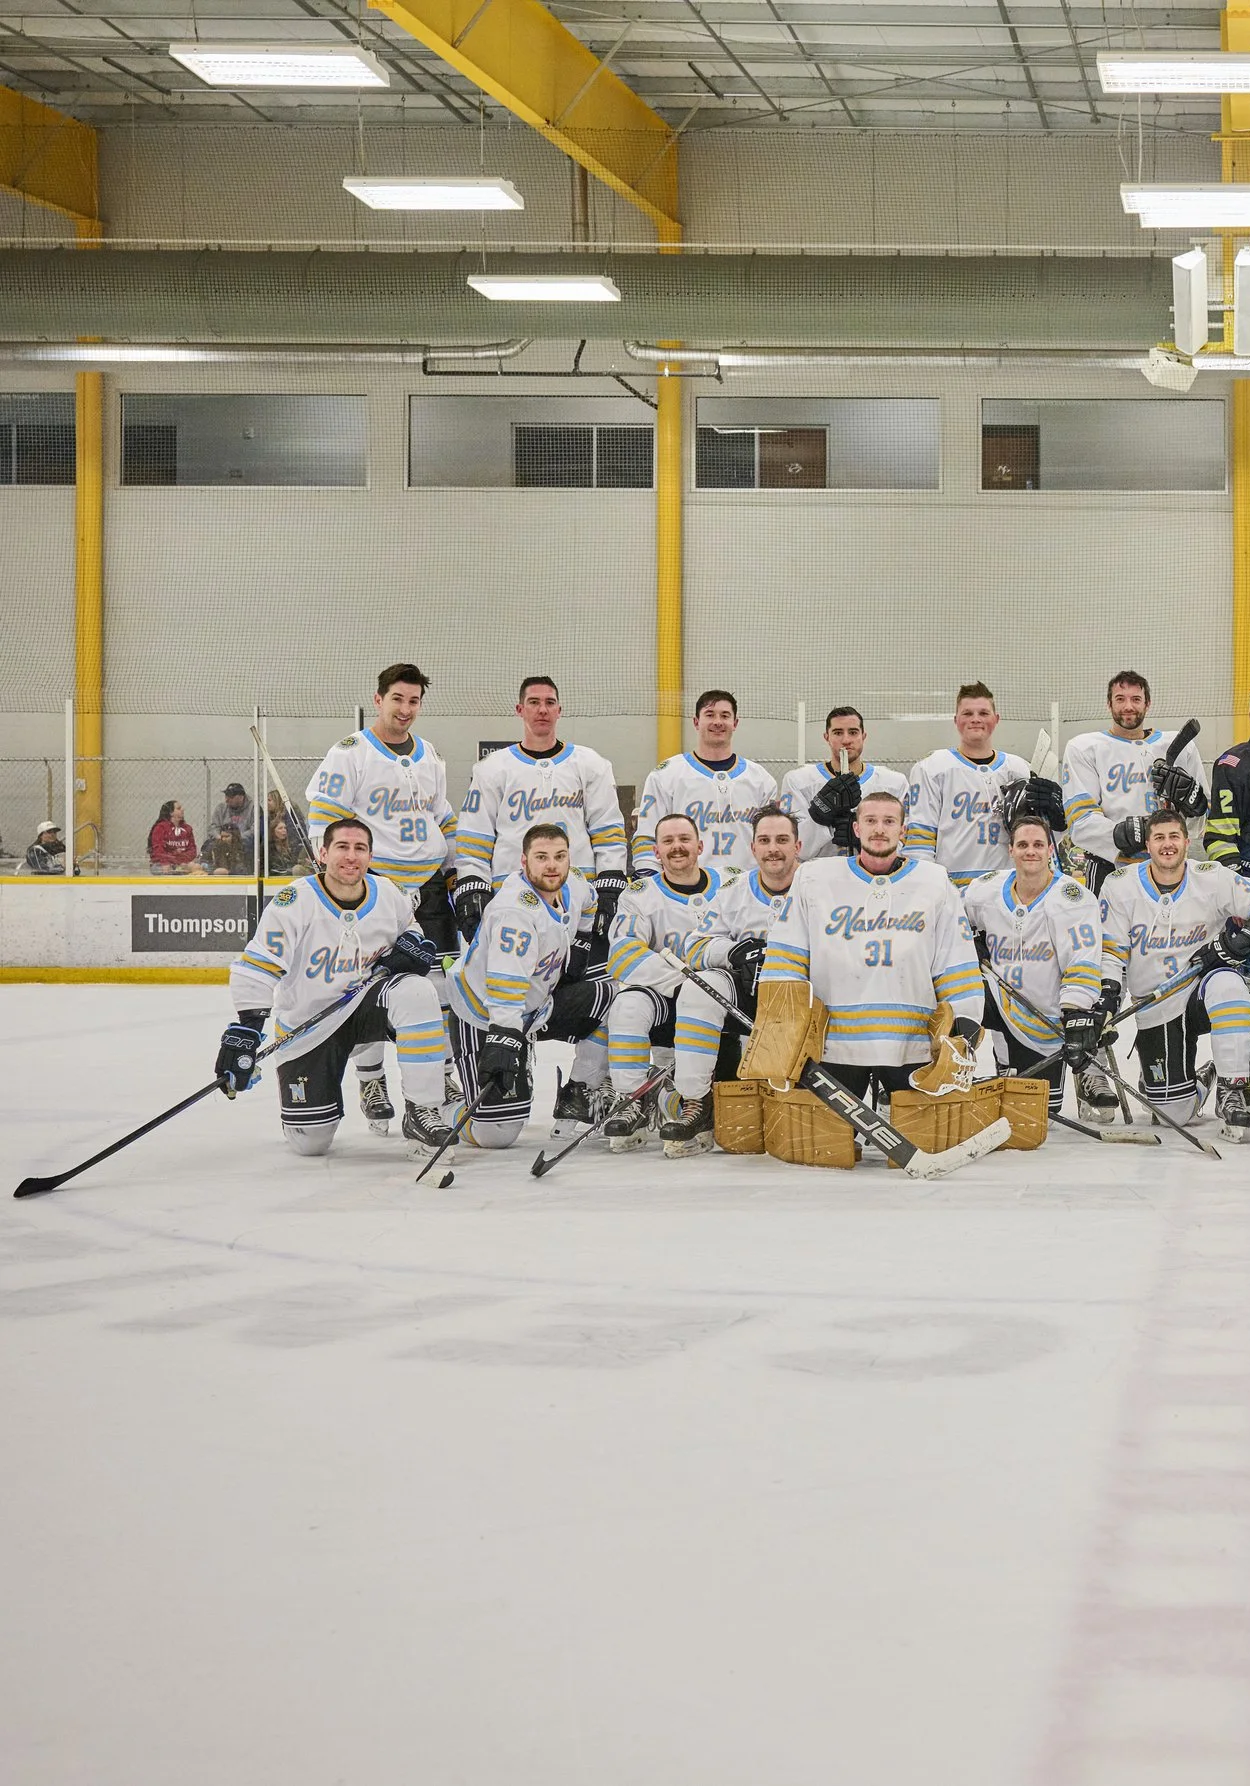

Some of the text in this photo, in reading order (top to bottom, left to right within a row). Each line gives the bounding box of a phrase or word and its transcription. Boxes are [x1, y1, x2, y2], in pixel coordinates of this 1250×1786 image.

[319, 771, 346, 797] 28
[1220, 789, 1233, 813] 2
[399, 817, 428, 842] 28
[976, 820, 1001, 845] 18
[711, 831, 737, 856] 17
[144, 913, 249, 938] Thompson
[616, 914, 638, 937] 71
[825, 905, 927, 941] Nashville
[266, 931, 283, 957] 5
[500, 927, 532, 957] 53
[1067, 924, 1096, 951] 19
[1130, 922, 1208, 951] Nashville
[864, 939, 893, 967] 31
[987, 934, 1055, 965] Nashville
[1003, 966, 1023, 990] 19
[1163, 956, 1180, 979] 3
[759, 1085, 776, 1098] TRUE
[978, 1081, 1004, 1096] TRUE
[811, 1070, 902, 1151] TRUE
